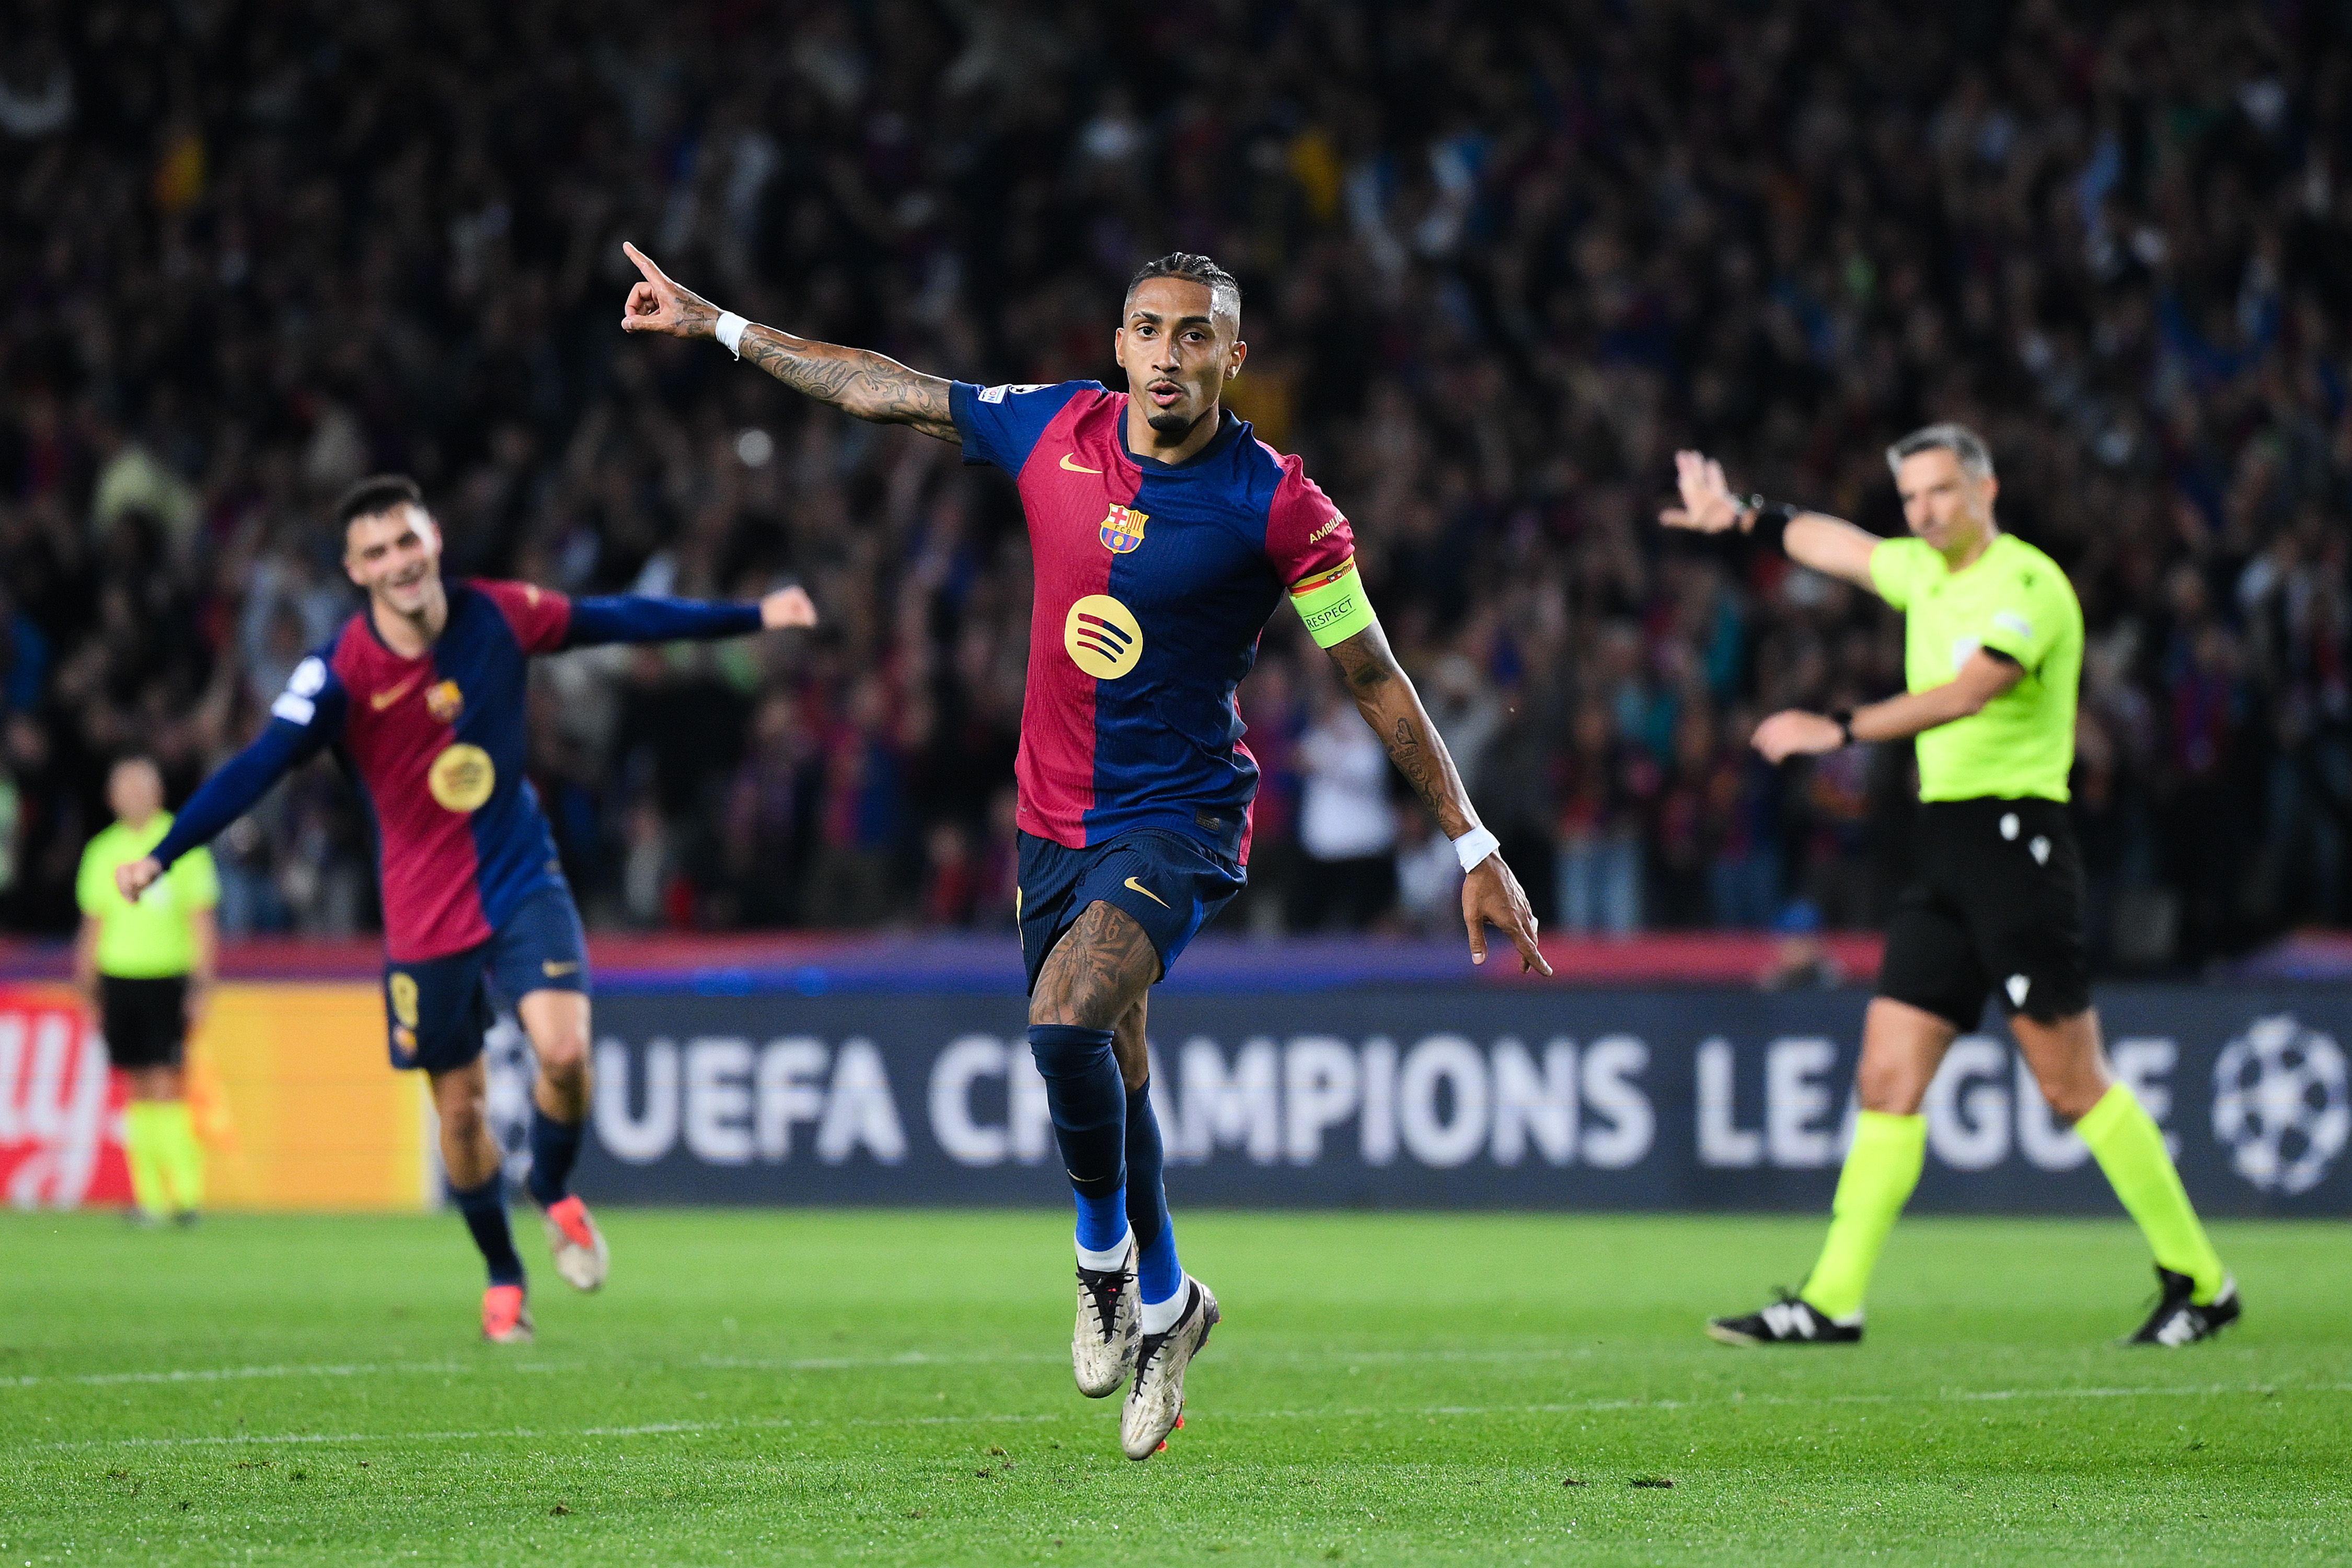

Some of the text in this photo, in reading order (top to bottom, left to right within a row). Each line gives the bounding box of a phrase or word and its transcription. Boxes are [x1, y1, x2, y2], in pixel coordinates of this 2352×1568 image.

[1310, 510, 1345, 544] AMBILIG
[1306, 598, 1352, 629] RESPECT
[592, 1036, 907, 1166] UEFA
[1695, 1035, 2180, 1170] LEGUE
